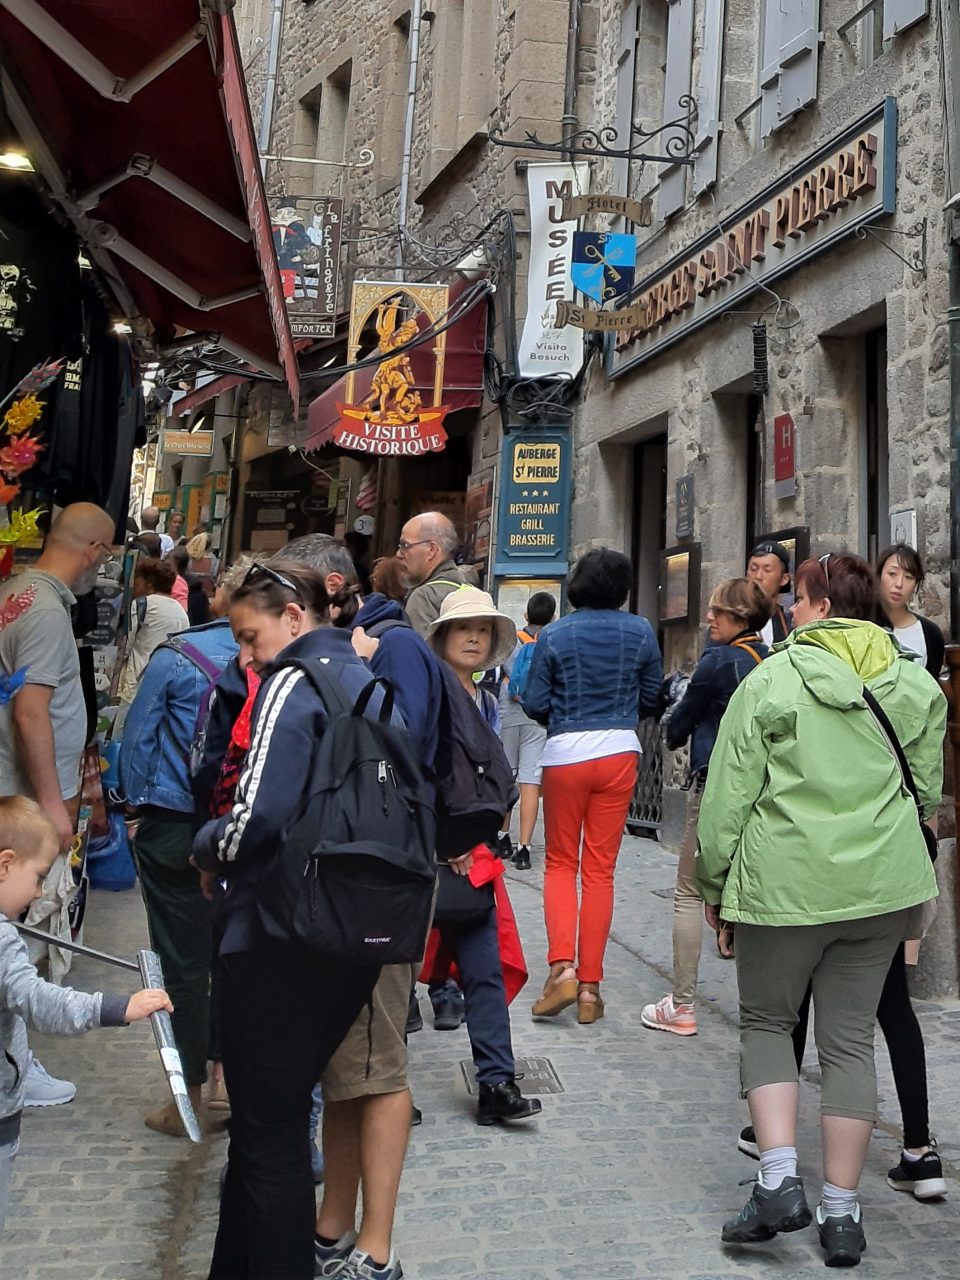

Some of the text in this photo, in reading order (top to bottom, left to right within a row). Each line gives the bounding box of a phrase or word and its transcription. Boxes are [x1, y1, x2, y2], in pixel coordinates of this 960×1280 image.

[545, 180, 573, 302] MUSÉE
[614, 133, 878, 353] ERGE SAINT PIERRE
[595, 314, 633, 327] Pierre
[290, 325, 332, 334] MPORTER
[536, 342, 567, 351] Visita
[530, 353, 570, 362] Besuch
[363, 422, 421, 440] VISITE
[781, 423, 791, 449] H
[339, 431, 442, 455] HISTORIQUE
[517, 448, 557, 460] AUBERGE
[527, 465, 558, 478] PIERRE
[509, 503, 560, 515] RESTAURANT
[521, 519, 544, 530] GRILL
[510, 534, 555, 546] BRASSERIE
